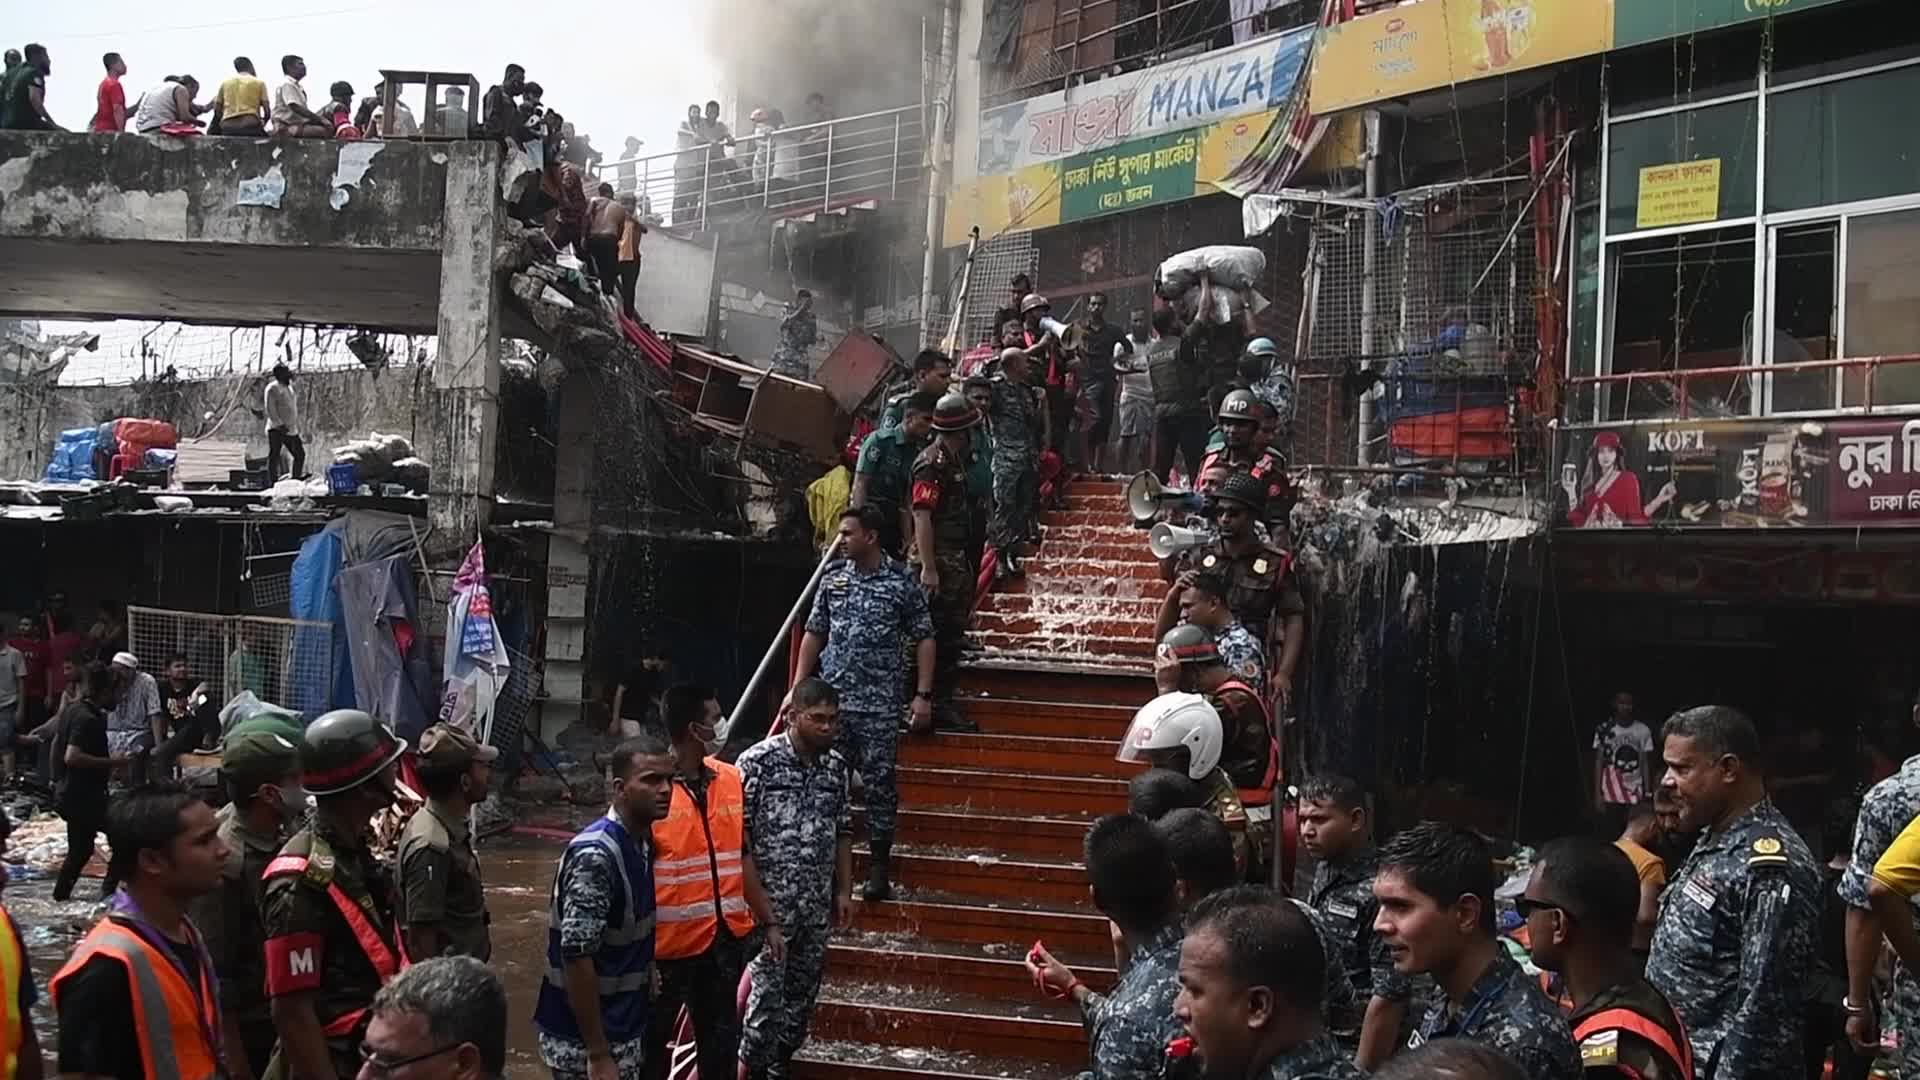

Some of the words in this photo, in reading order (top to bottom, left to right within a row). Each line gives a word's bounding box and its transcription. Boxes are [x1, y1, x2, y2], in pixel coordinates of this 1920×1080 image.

[1147, 56, 1264, 126] MANZA
[1064, 167, 1089, 189] ঢাকা
[1093, 155, 1116, 184] নিউ
[1118, 152, 1152, 186] সুপার
[1154, 134, 1196, 170] মার্কেট
[1226, 400, 1248, 412] MP
[1648, 430, 1705, 452] KOFI
[1739, 448, 1760, 496] KOFI
[1839, 435, 1894, 489] নুর
[1869, 495, 1904, 511] ঢাকা
[289, 947, 314, 976] M
